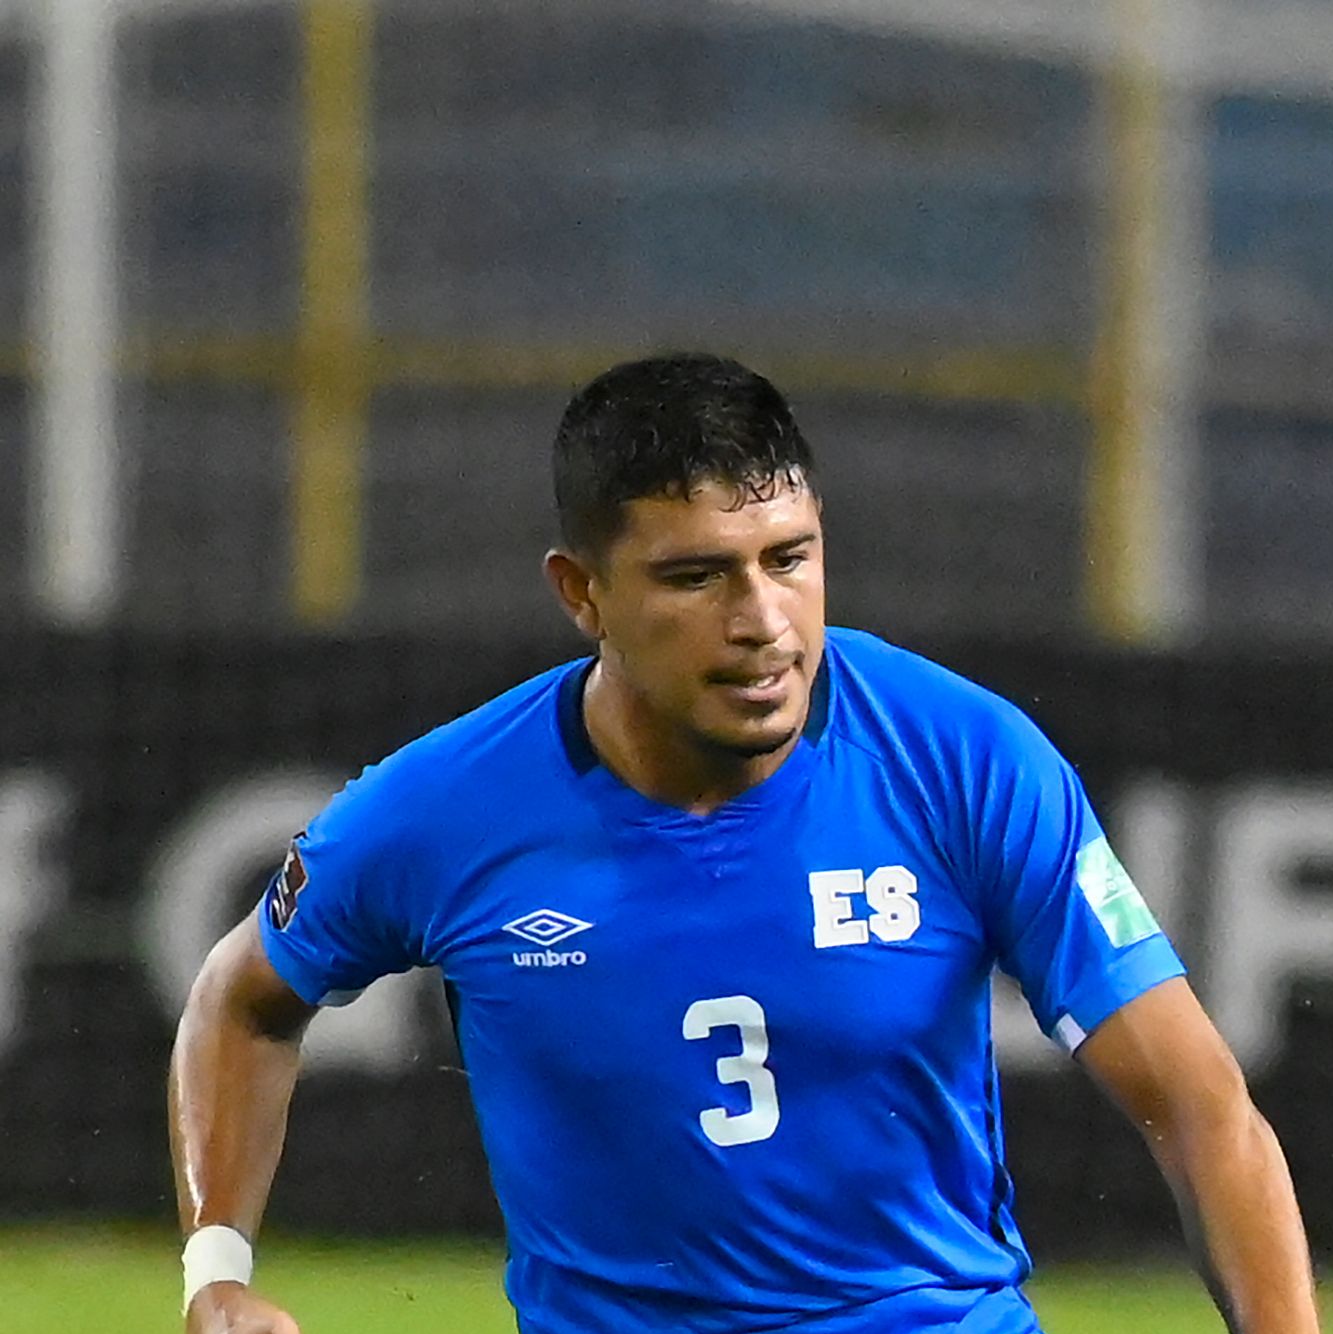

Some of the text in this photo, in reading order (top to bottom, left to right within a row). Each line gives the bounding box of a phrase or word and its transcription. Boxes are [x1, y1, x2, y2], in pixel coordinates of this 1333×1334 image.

[808, 865, 921, 948] ES
[512, 949, 588, 967] umbro
[682, 995, 780, 1147] 3
